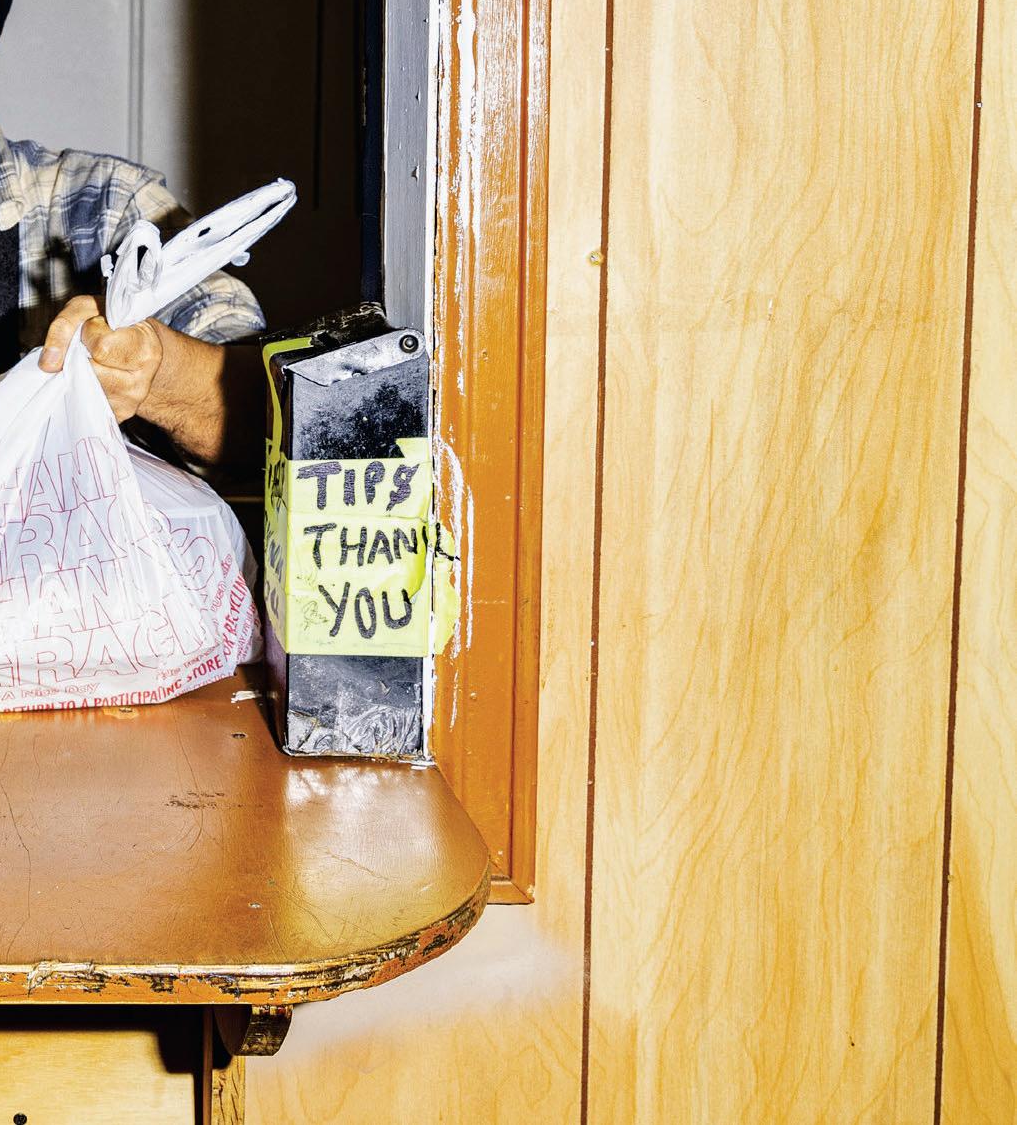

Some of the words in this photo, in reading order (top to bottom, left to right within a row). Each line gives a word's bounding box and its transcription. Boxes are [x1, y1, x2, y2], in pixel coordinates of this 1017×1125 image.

[296, 460, 419, 512] TIPS
[303, 521, 461, 568] THANK
[318, 581, 413, 639] YOU
[82, 698, 91, 711] A
[223, 569, 248, 637] RECYCLIN
[1, 691, 15, 702] A
[21, 687, 61, 699] Nice
[65, 681, 100, 695] Day
